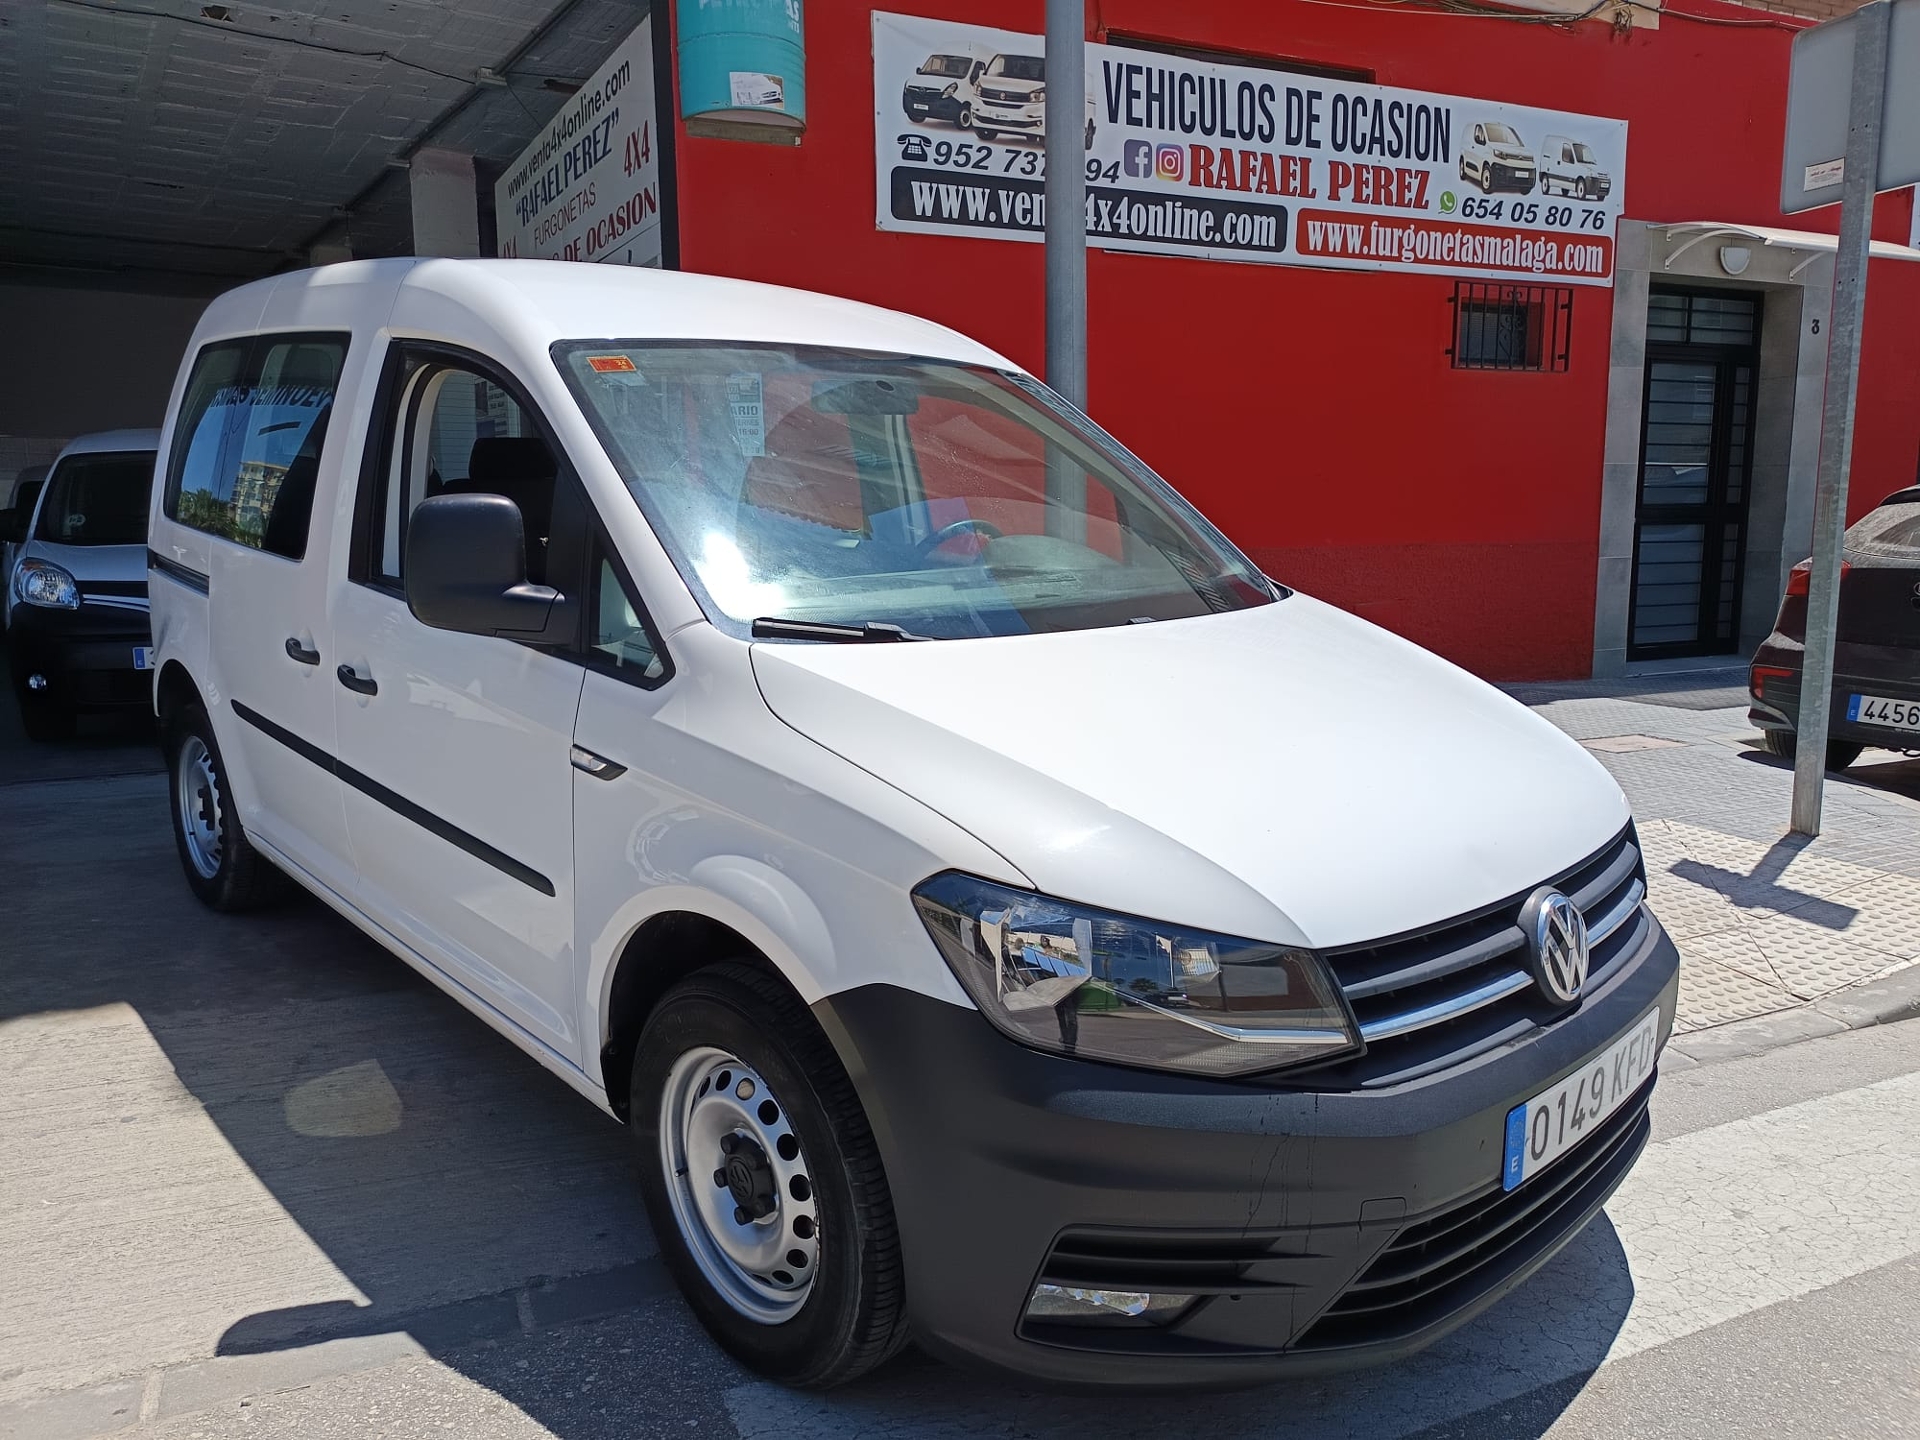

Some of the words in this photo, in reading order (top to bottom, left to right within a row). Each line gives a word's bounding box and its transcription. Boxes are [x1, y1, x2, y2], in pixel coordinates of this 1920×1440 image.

[508, 60, 630, 198] www.venta4x4online.com
[1103, 60, 1276, 144] VEHICULOS
[1286, 87, 1322, 149] DE
[1331, 93, 1450, 163] OCASION
[534, 182, 596, 248] FURGONETAS
[623, 120, 650, 178] 4X4
[933, 140, 993, 171] 952
[1003, 148, 1045, 177] 73
[1188, 143, 1316, 198] RAFAEL
[1328, 160, 1429, 209] PEREZ
[586, 182, 657, 256] OCASION
[910, 180, 1277, 248] www.ven4x4online.com
[1307, 219, 1603, 273] www.furgonetasmalaga.com
[1461, 196, 1502, 221] 654
[1510, 202, 1538, 224] 05
[1545, 205, 1572, 228] 80
[1580, 208, 1606, 230] 76
[1811, 318, 1820, 335] 3
[1863, 700, 1920, 725] 4456
[1530, 1066, 1605, 1161] 0149
[1611, 1025, 1652, 1103] KFD
